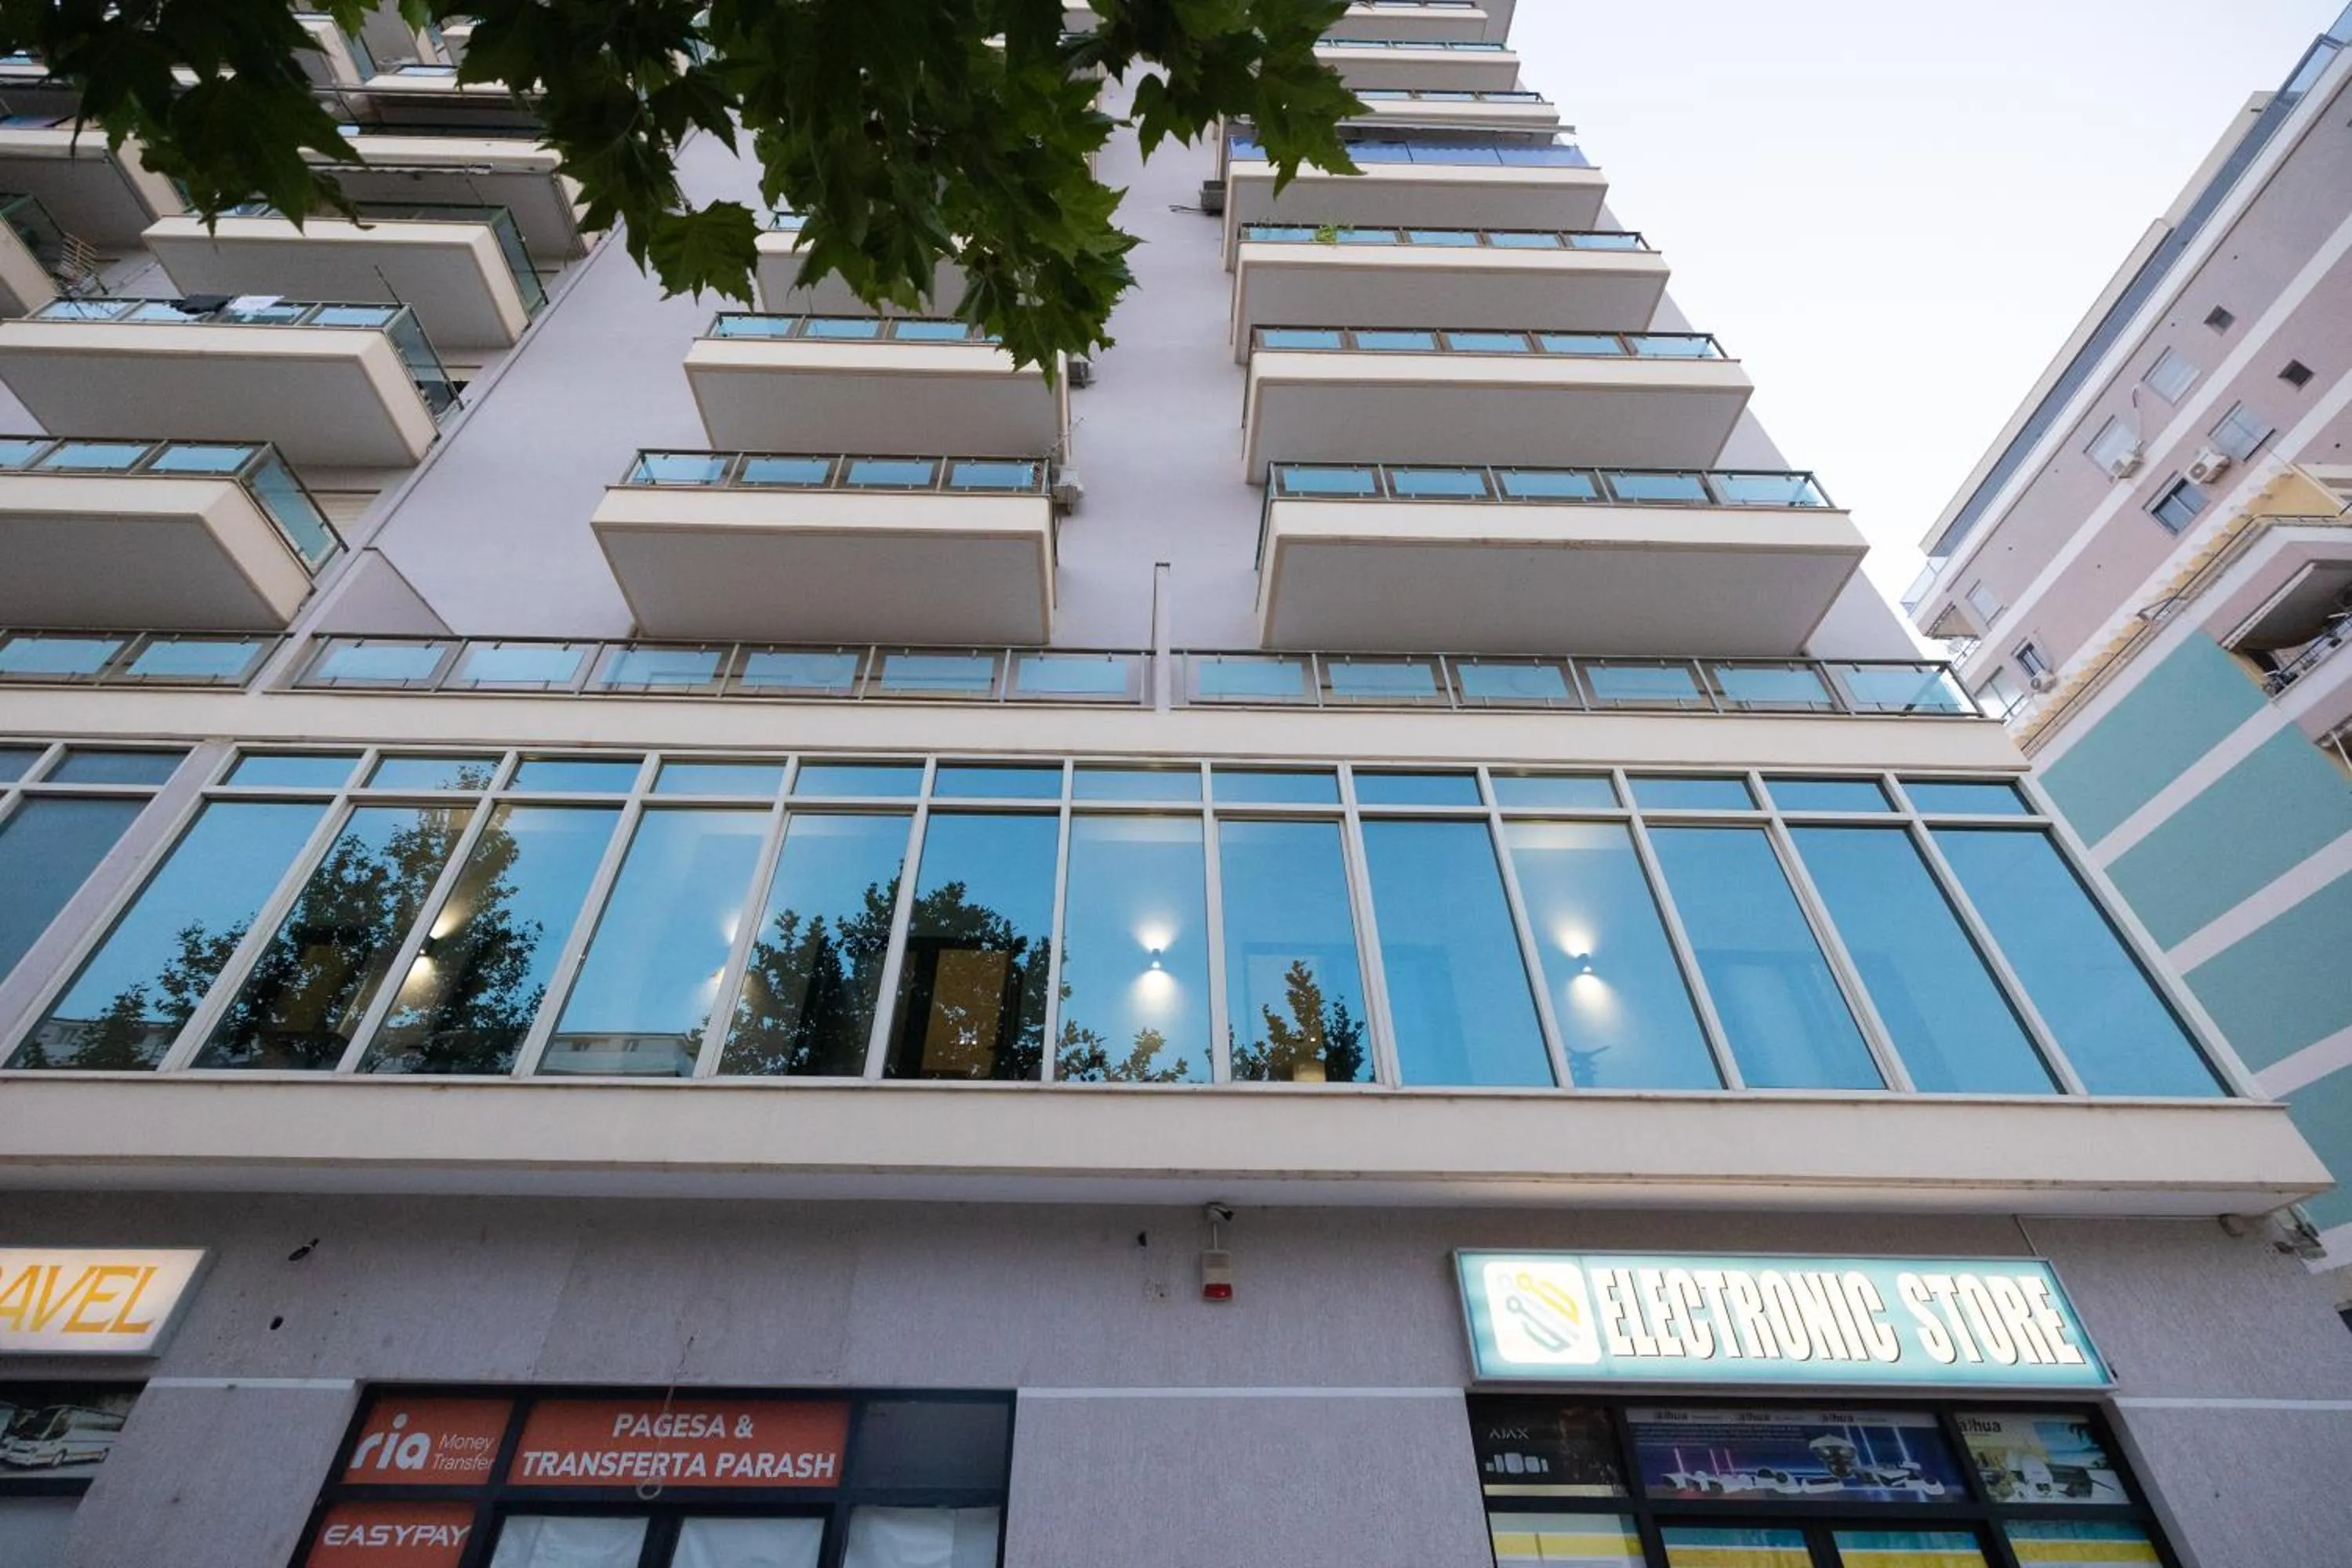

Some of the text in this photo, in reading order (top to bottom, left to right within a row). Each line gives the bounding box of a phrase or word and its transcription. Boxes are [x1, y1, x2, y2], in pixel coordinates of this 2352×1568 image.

[0, 1265, 158, 1333] AVEL
[1590, 1269, 2085, 1365] ELECTRONIC STORE
[612, 1414, 754, 1438] PAGESA &
[1490, 1428, 1530, 1439] AJAX
[350, 1413, 430, 1470] ria
[438, 1433, 495, 1453] Money
[432, 1452, 495, 1471] Transfer
[522, 1452, 836, 1478] TRANSFERTA PARASH
[323, 1524, 471, 1547] EASYPAY
